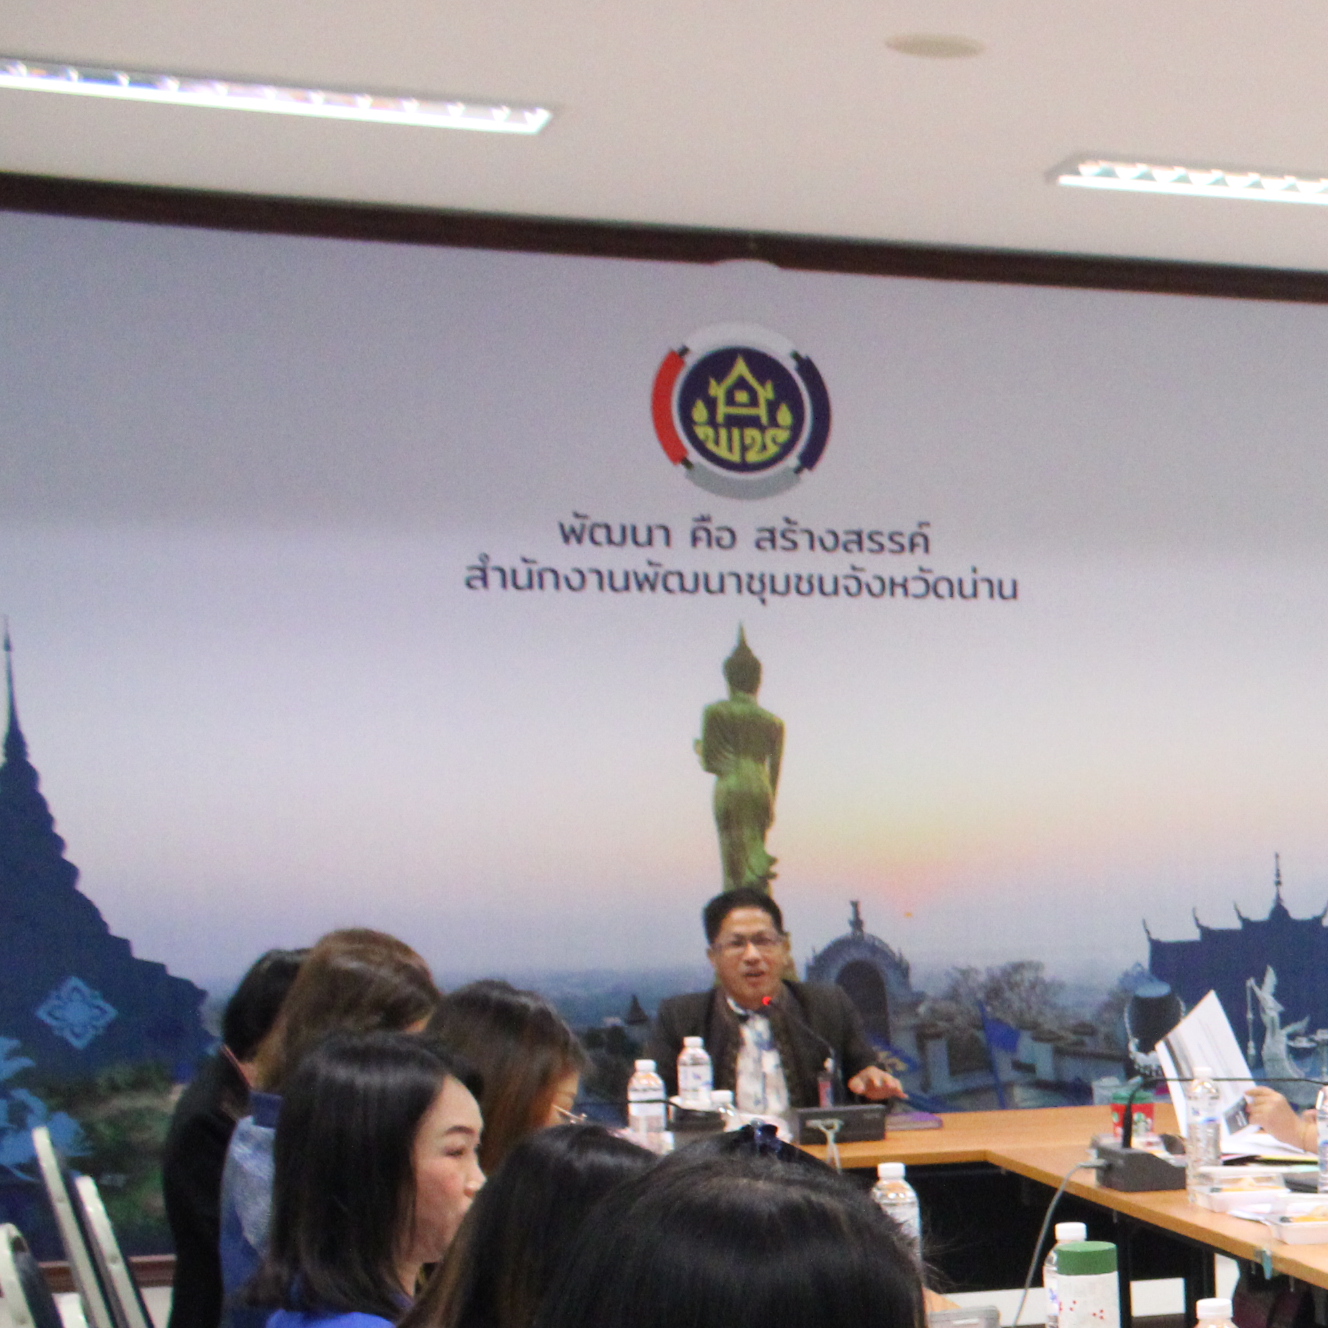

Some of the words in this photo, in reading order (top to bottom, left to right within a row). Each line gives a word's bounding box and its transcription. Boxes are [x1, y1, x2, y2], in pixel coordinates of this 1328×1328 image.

[558, 510, 672, 548] พัฒนา
[690, 513, 738, 551] คือ
[754, 516, 931, 555] สร้างสรรค์
[464, 552, 1019, 607] สำนักงานพัฒนาชุมชนจังหวัดน่าน
